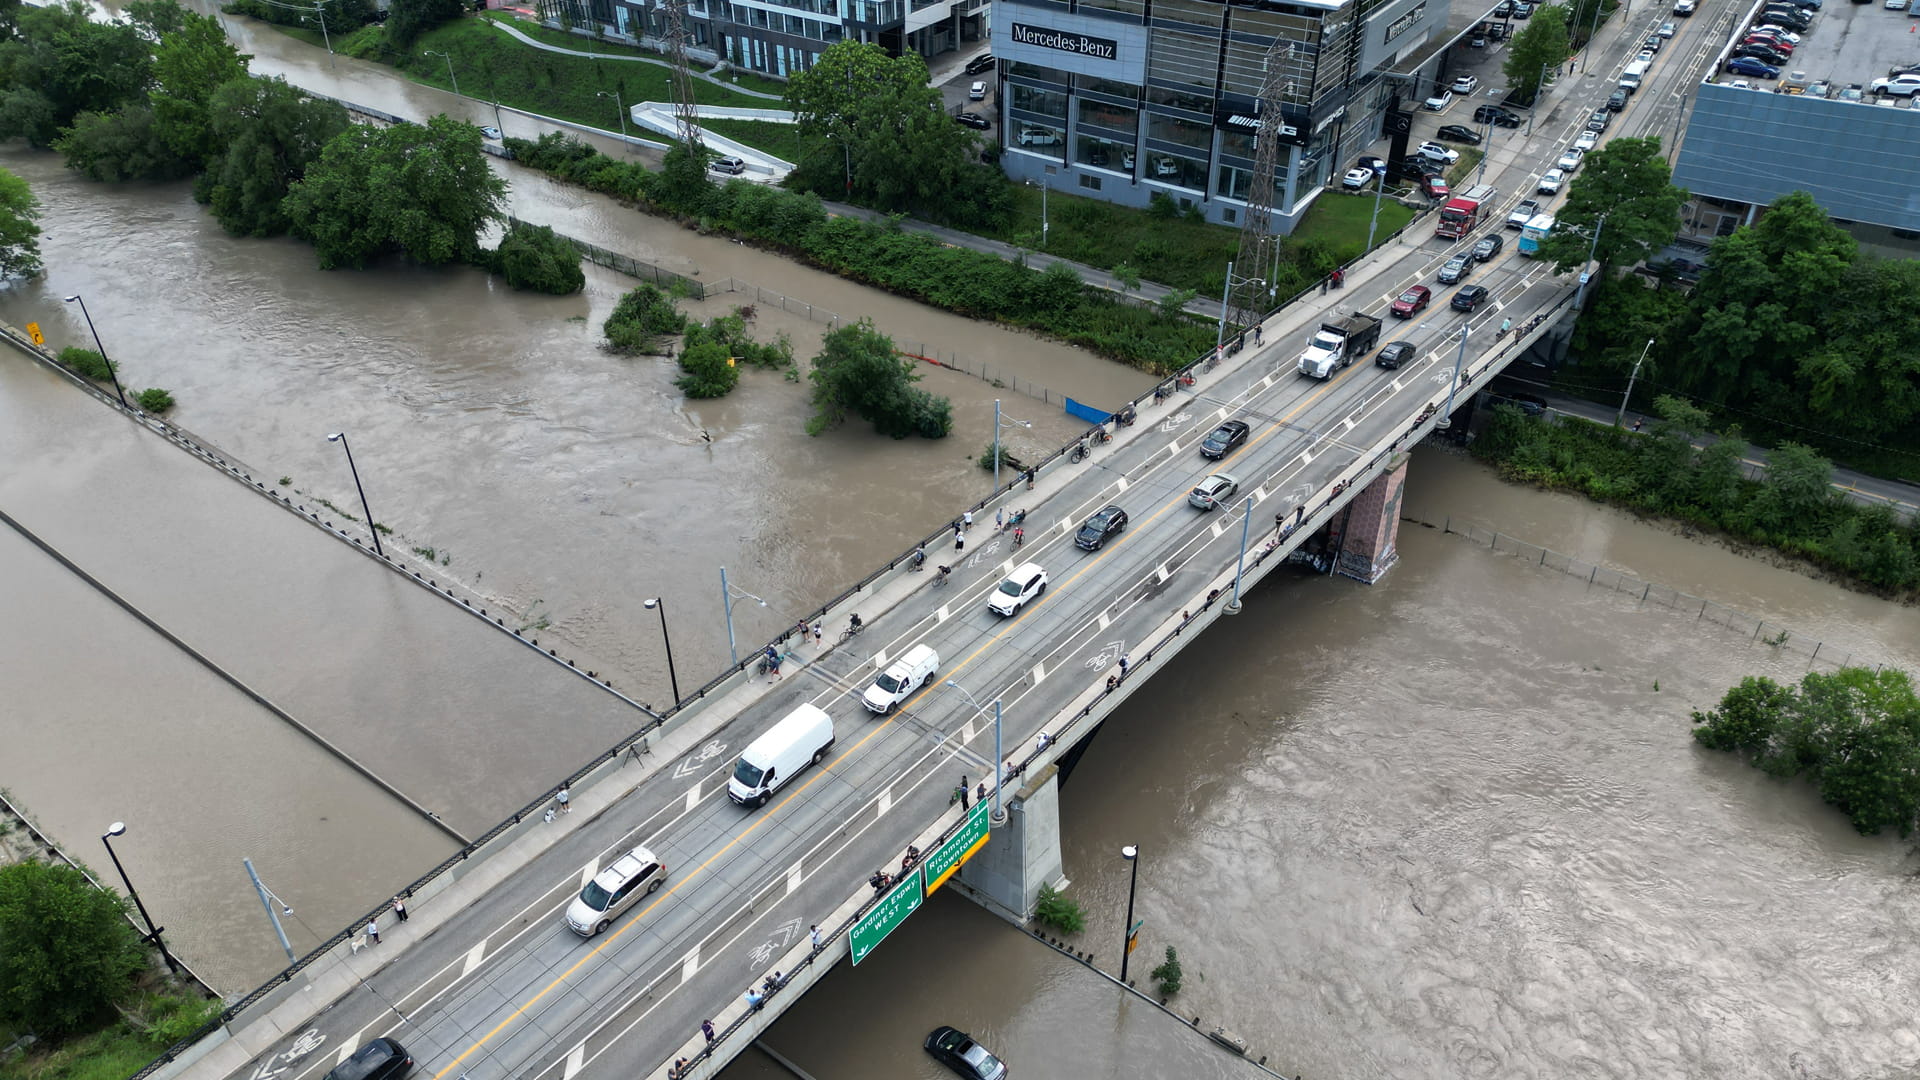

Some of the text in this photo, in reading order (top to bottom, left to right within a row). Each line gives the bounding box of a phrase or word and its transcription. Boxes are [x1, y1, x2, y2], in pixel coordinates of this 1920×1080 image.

[1013, 24, 1113, 58] Mercedes-Benz
[929, 817, 985, 871] Richmond St.
[936, 831, 979, 874] Downtown
[853, 903, 889, 939] Gardiner
[874, 904, 900, 931] WEST
